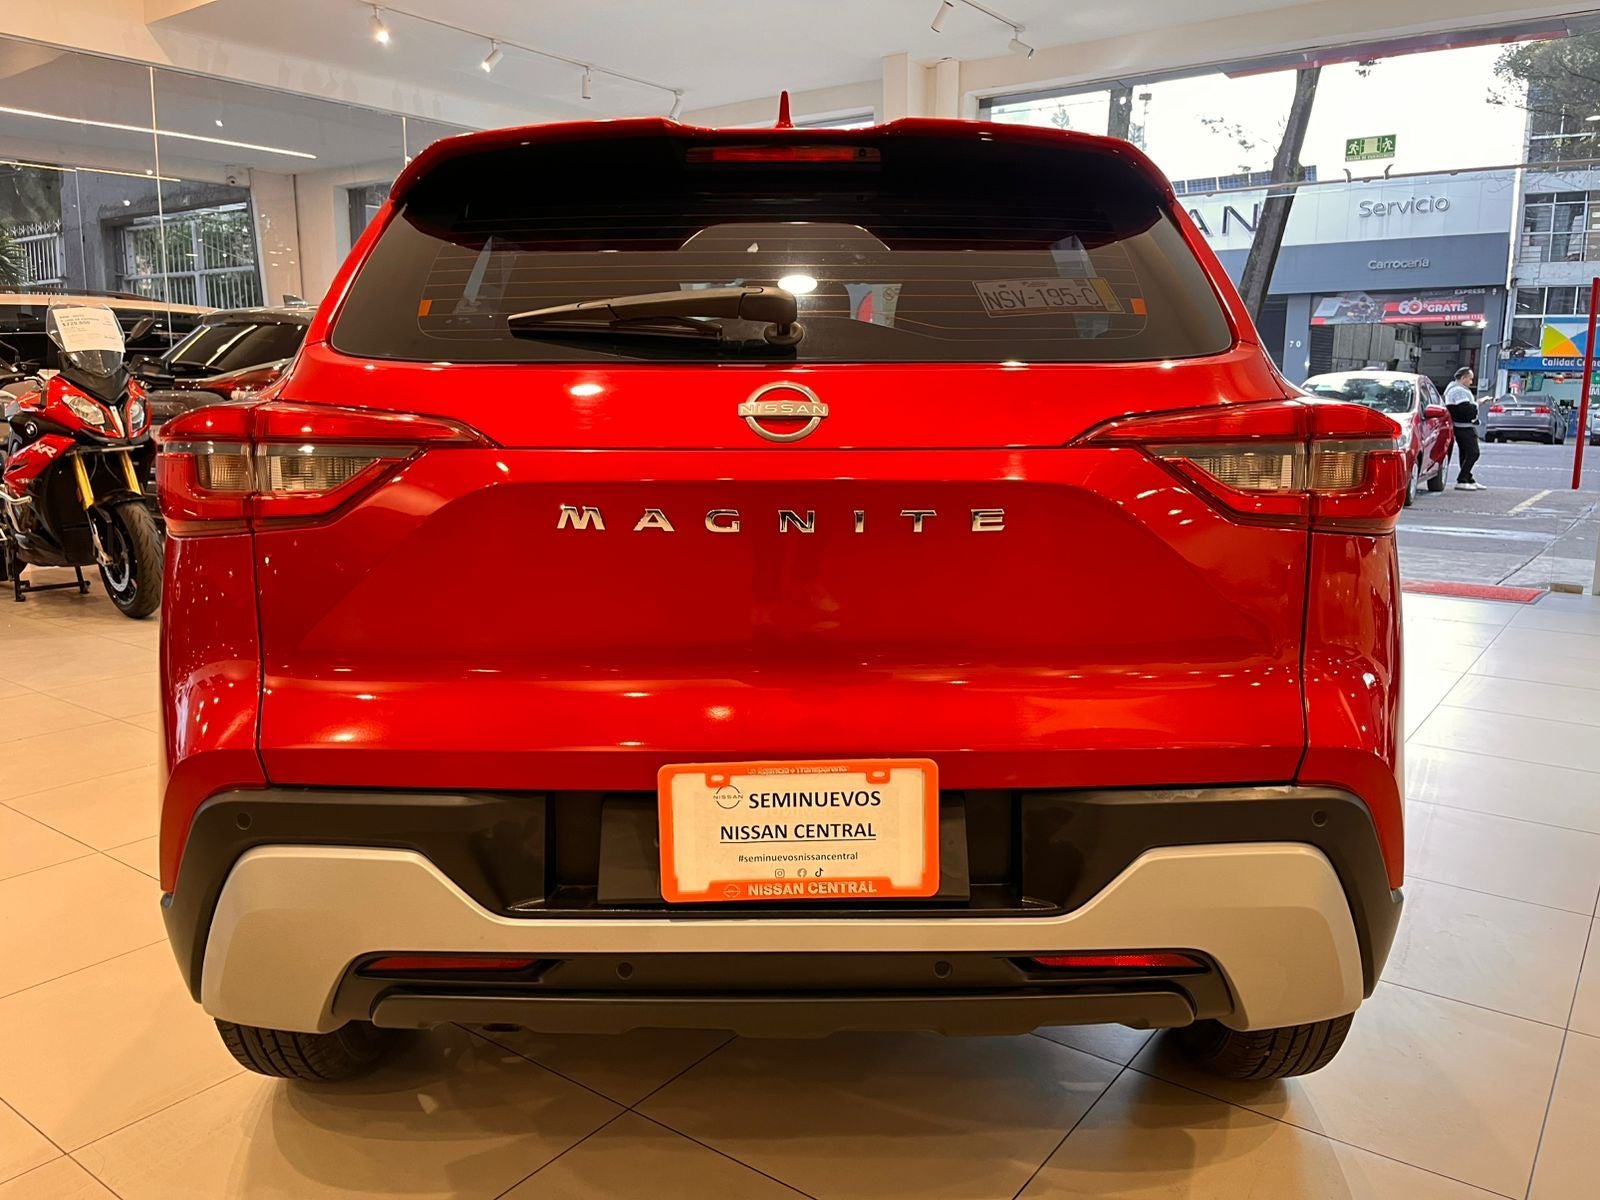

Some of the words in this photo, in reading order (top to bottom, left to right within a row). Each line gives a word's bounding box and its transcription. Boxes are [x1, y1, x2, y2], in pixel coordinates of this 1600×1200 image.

[1359, 195, 1450, 217] Servicio
[984, 287, 1099, 310] NSV-195-C
[740, 403, 826, 414] NISSAN
[557, 504, 1005, 533] MAGNITE
[748, 790, 881, 809] SEMINUEVOS
[720, 824, 788, 841] NISSAN
[793, 822, 877, 839] CENTRAL
[738, 851, 859, 863] #seminuevosnissancentral
[747, 883, 804, 897] NISSAN
[807, 880, 877, 894] CENTRAL
